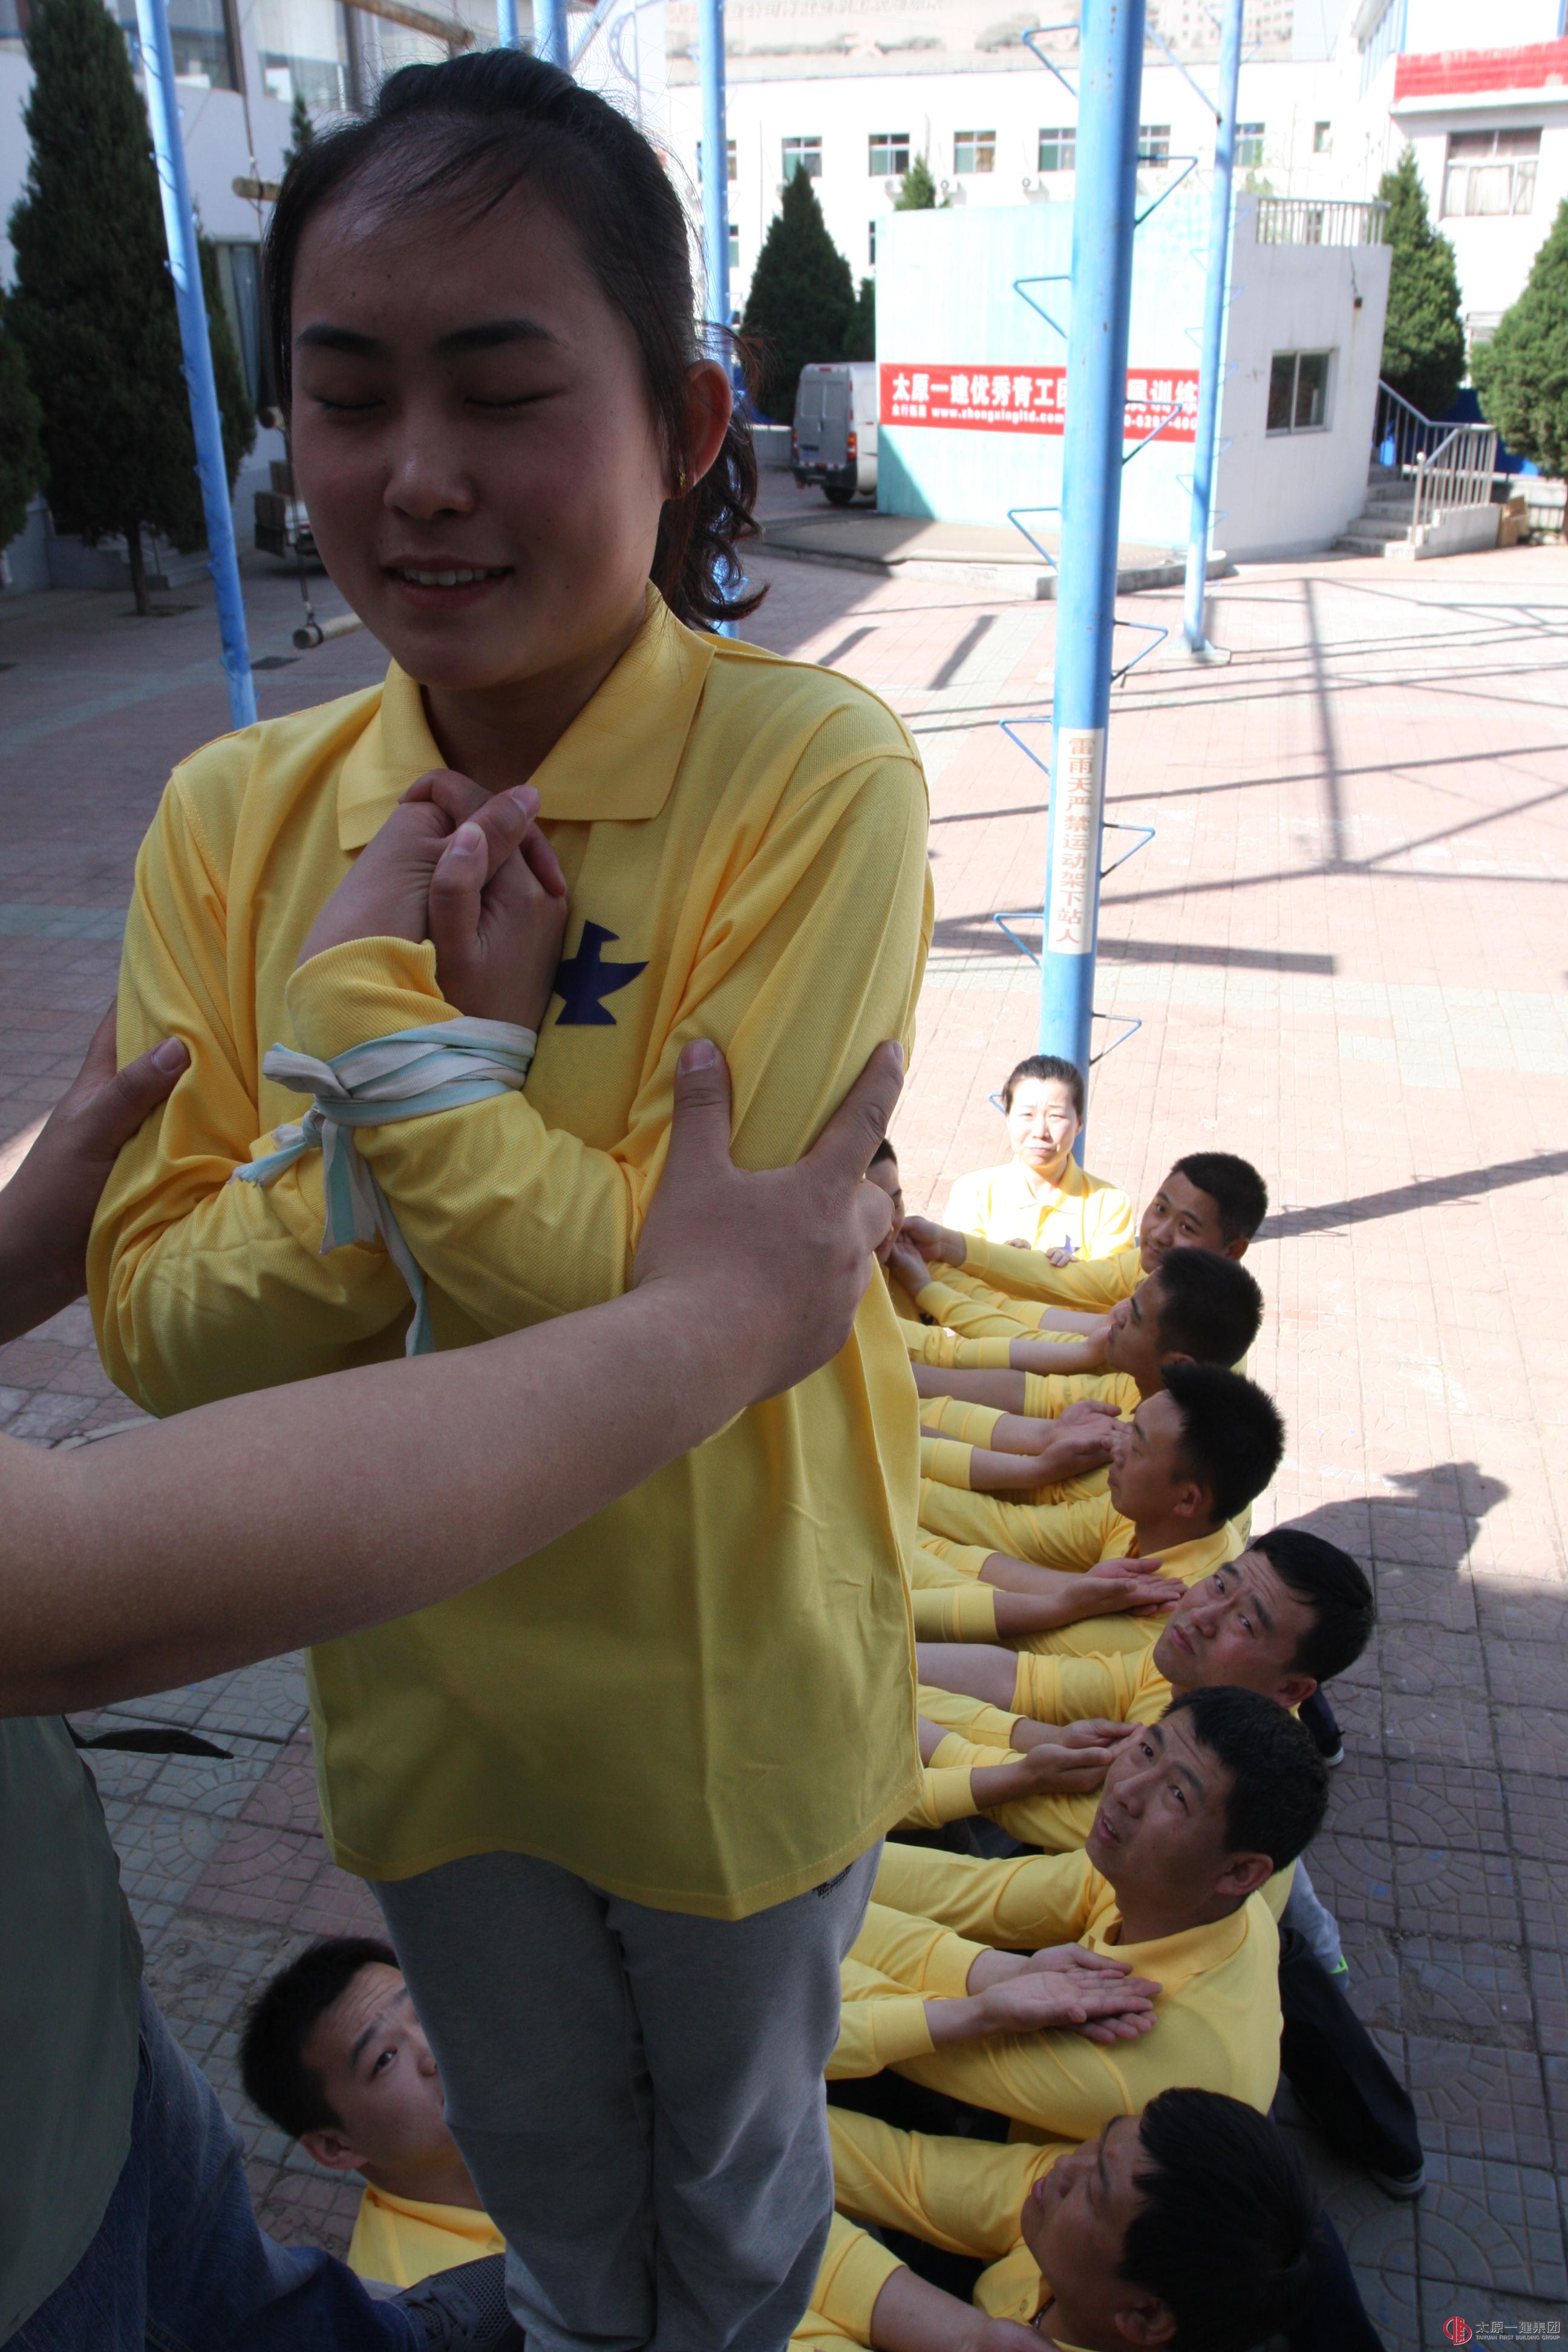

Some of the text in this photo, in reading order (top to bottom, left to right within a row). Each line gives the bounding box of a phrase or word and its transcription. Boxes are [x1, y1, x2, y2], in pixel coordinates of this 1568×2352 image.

[932, 408, 1065, 424] www.zhongxingltd.com
[1056, 738, 1095, 944] 雷雨天严禁运动架下站人
